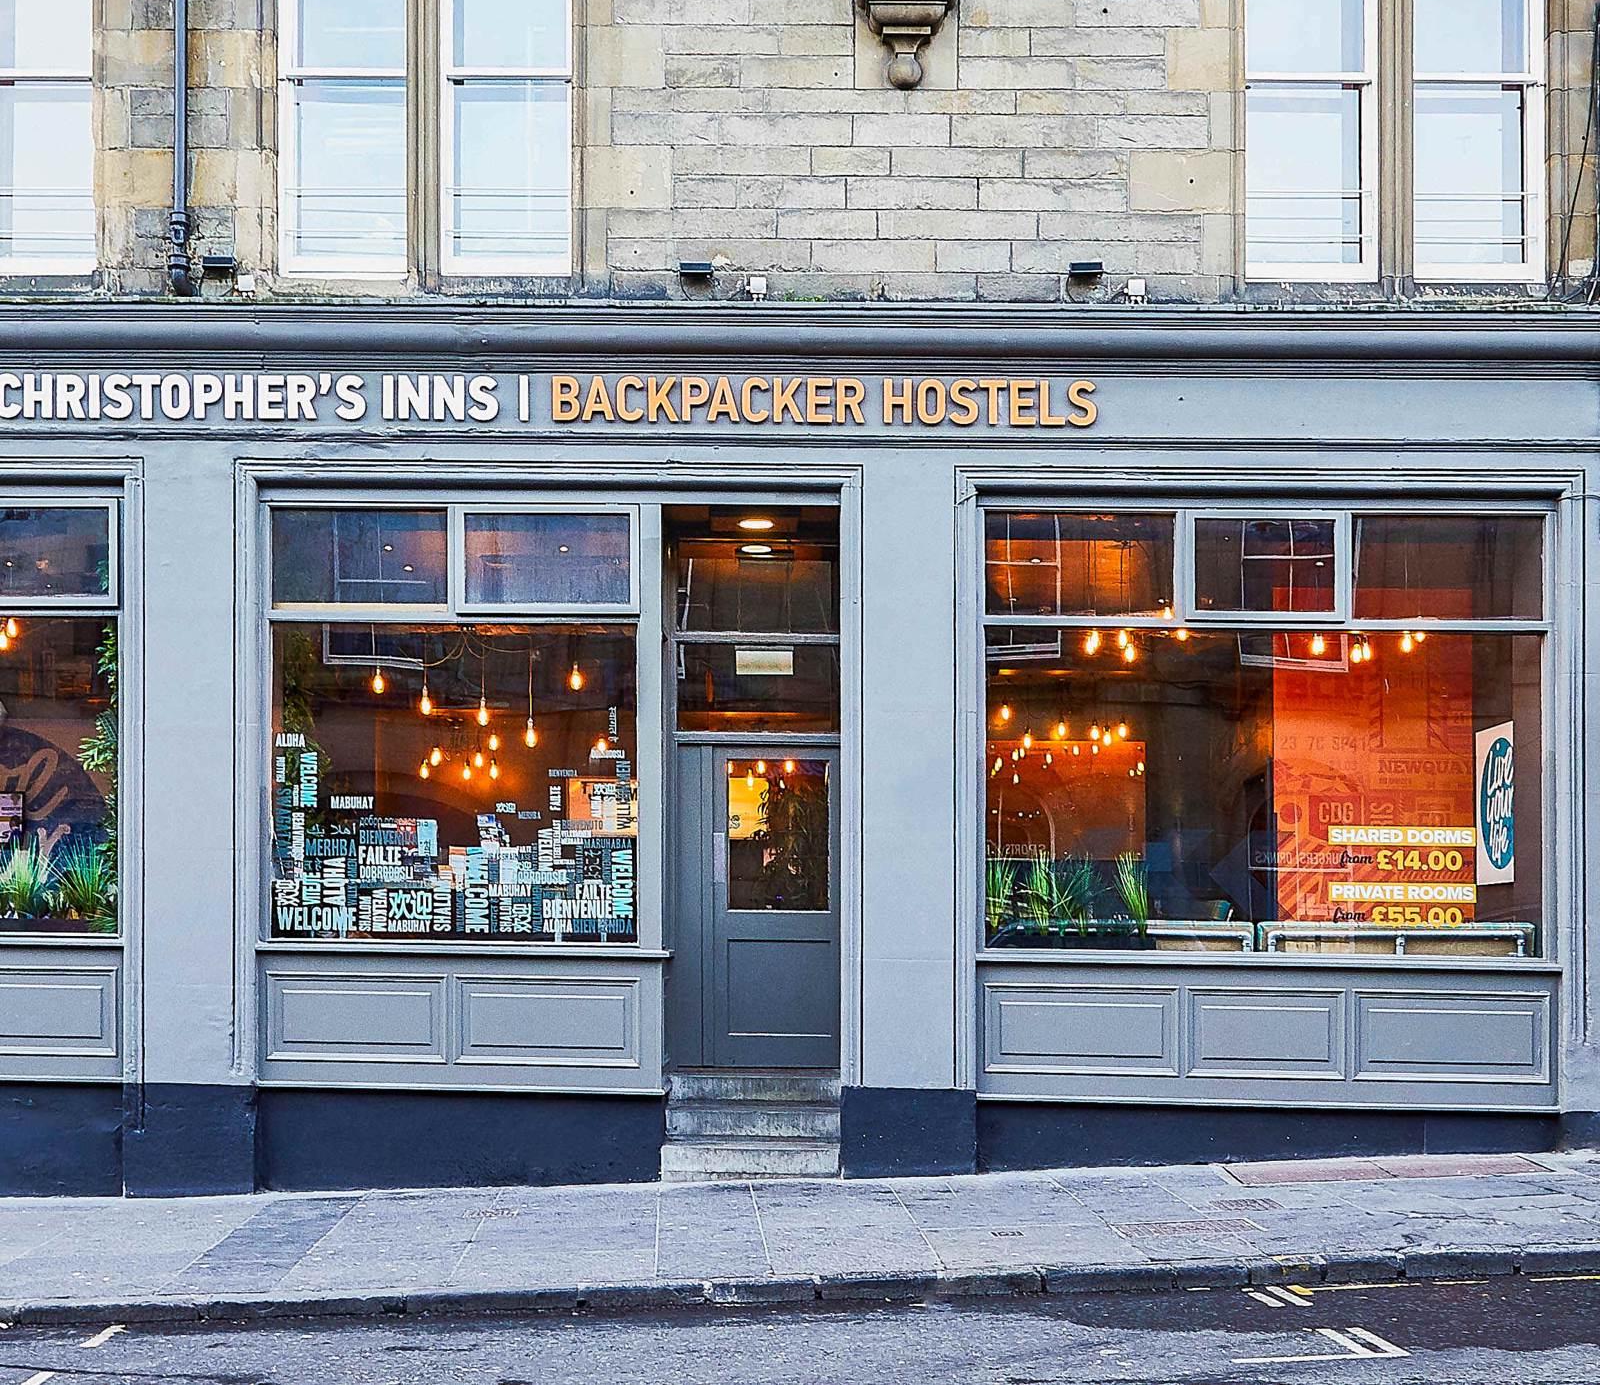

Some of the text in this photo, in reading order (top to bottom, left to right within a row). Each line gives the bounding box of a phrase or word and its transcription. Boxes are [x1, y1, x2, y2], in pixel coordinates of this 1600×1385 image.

[0, 372, 368, 421] CHRISTOPHER'S
[382, 373, 500, 421] INNS
[551, 375, 866, 424] BACKPACKER
[883, 378, 1098, 428] HOSTELS
[276, 733, 305, 747] ALOHA
[300, 752, 317, 807] WELCOME
[1487, 743, 1514, 796] Live
[331, 796, 374, 809] MABUHAY
[549, 786, 561, 811] FAILTE
[1487, 785, 1514, 823] your
[1318, 802, 1354, 823] CDG
[1330, 828, 1473, 844] SHARED DORMS
[1489, 819, 1508, 866] life
[358, 845, 402, 865] FAILTE
[538, 828, 553, 871] WELKOM
[1340, 849, 1463, 871] from £14.00
[323, 857, 346, 907] ALOHA
[488, 883, 532, 897] MABUHAY
[575, 883, 613, 900] FAILTE
[611, 849, 633, 919] WELCOME
[1331, 885, 1474, 901] PRIVATE ROOMS
[358, 896, 371, 932] SHALOM
[372, 889, 388, 932] WELKOM
[388, 889, 433, 920] 欢迎
[433, 880, 451, 932] SHALOM
[500, 897, 512, 933] SHALOM
[542, 899, 613, 919] BIENVENUE
[1333, 906, 1463, 928] from £55.00
[276, 906, 357, 931] WELCOME
[387, 919, 431, 933] MABUHAY
[542, 918, 573, 933] ALOHA
